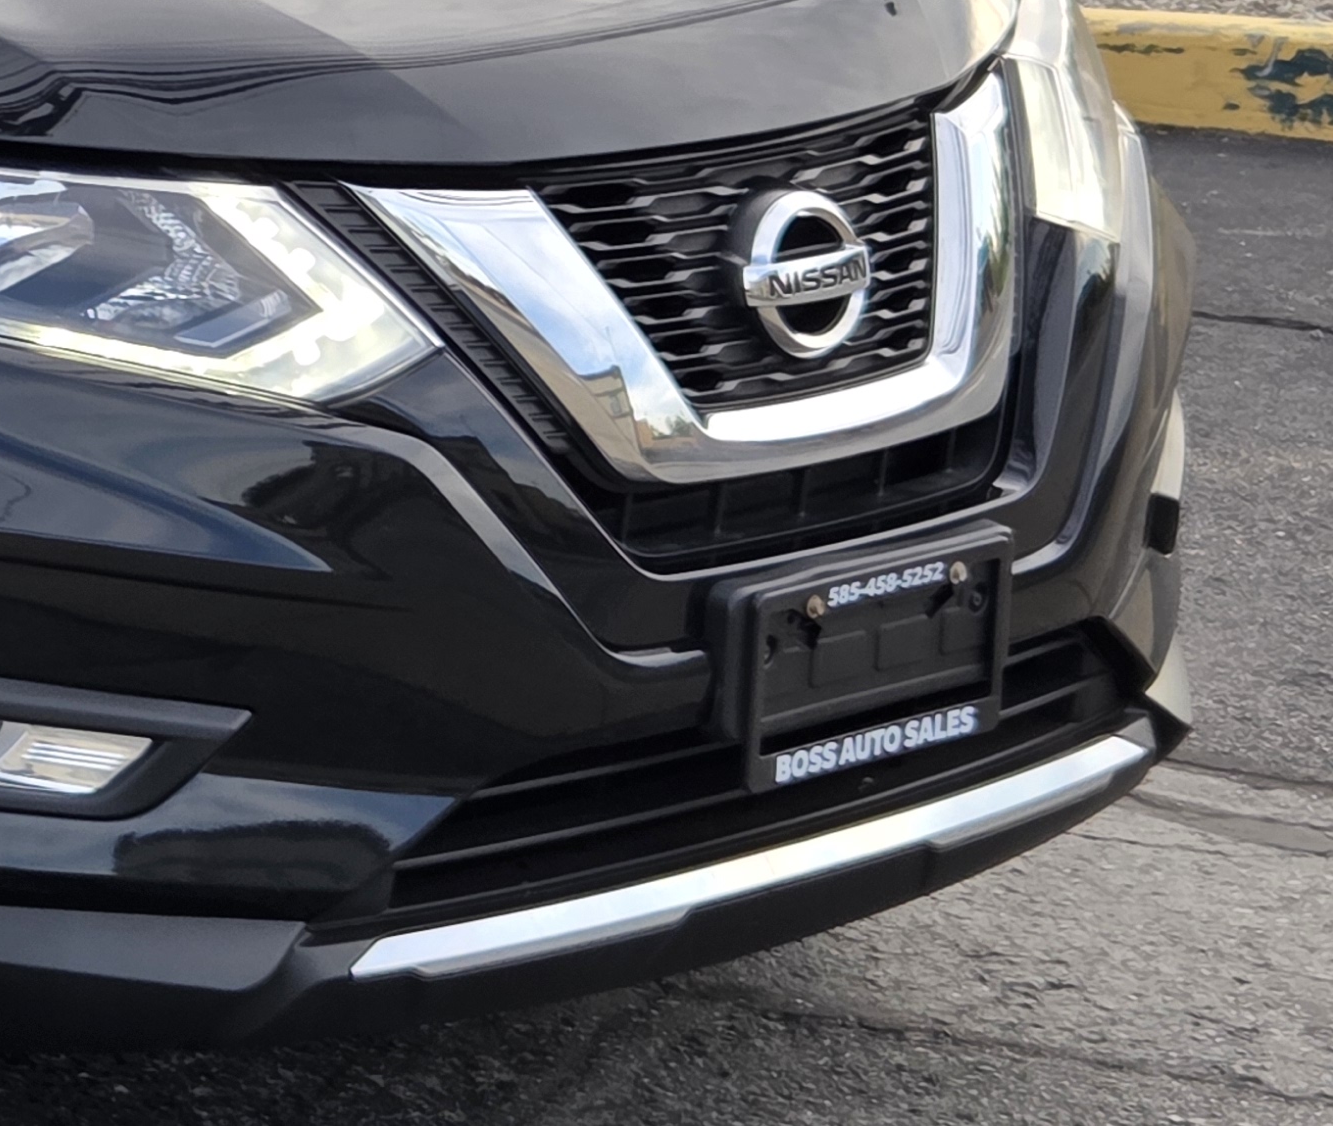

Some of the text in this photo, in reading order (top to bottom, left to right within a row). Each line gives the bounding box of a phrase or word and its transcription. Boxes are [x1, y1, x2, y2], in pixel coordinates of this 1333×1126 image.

[768, 254, 867, 297] NISSAN
[827, 561, 945, 607] 585-458-5252
[775, 705, 976, 784] BOSS AUTO SALES
